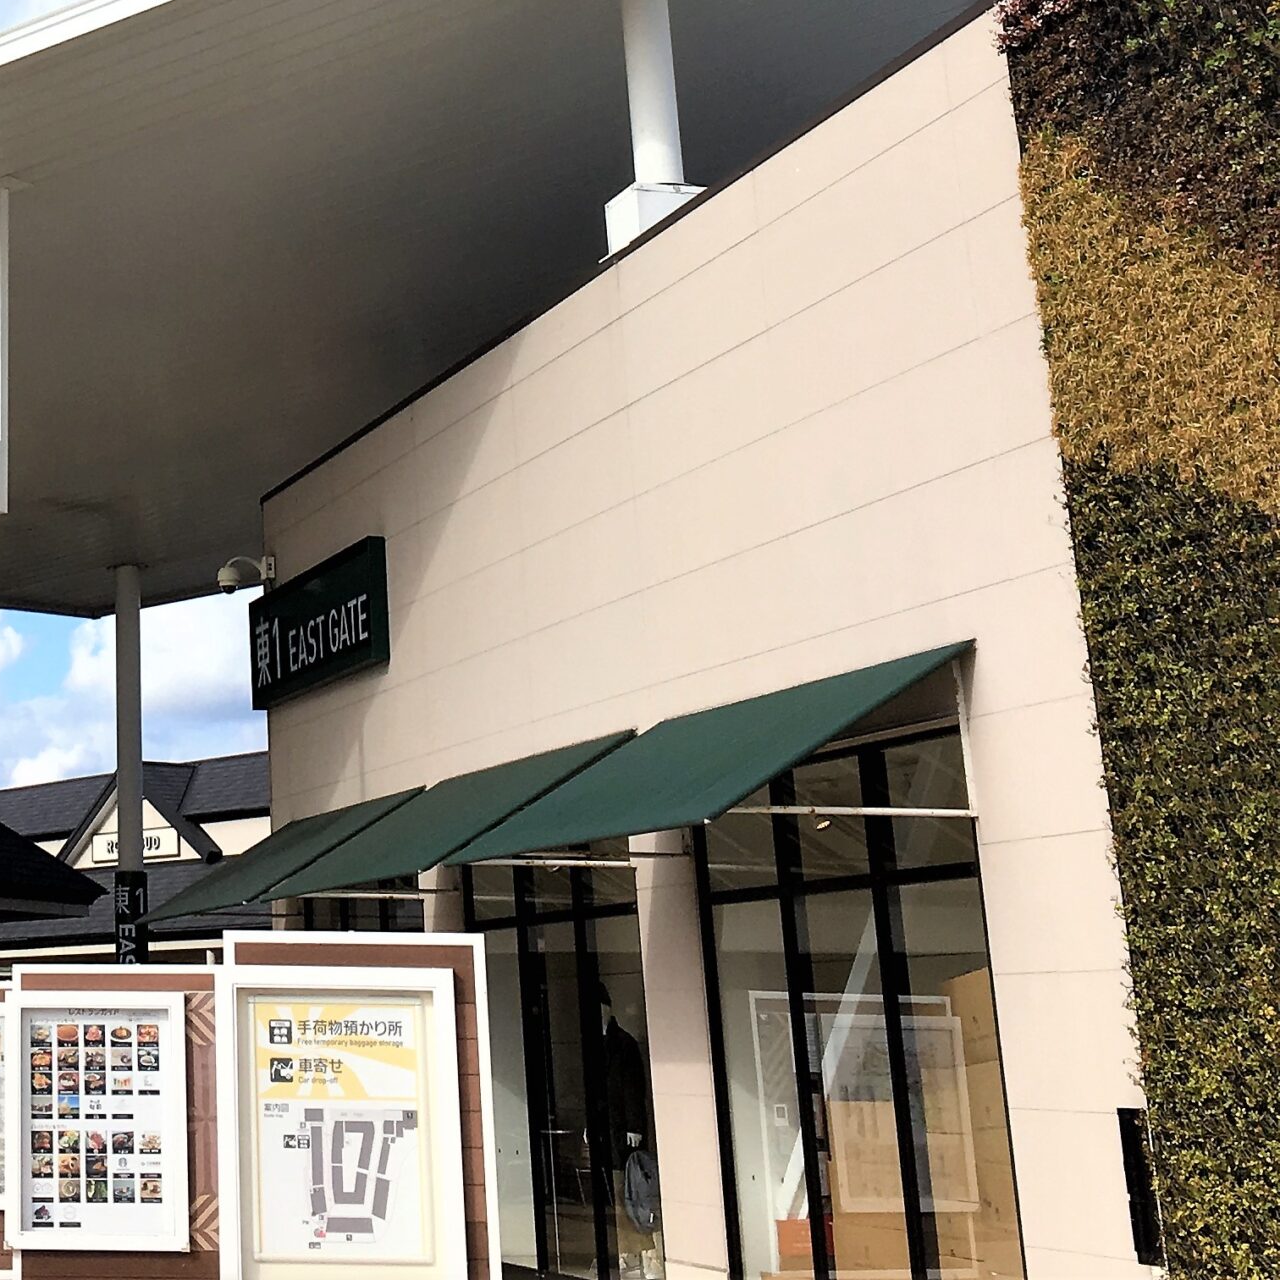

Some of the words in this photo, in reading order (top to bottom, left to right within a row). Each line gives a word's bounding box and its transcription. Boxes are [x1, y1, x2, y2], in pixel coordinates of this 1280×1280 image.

[288, 614, 325, 672] EAST
[328, 593, 368, 653] GATE
[297, 1019, 403, 1037] 手荷物預かり所
[314, 1039, 348, 1047] temporary
[350, 1039, 377, 1048] baggage
[378, 1040, 403, 1048] storage
[298, 1058, 344, 1074] 車寄せ
